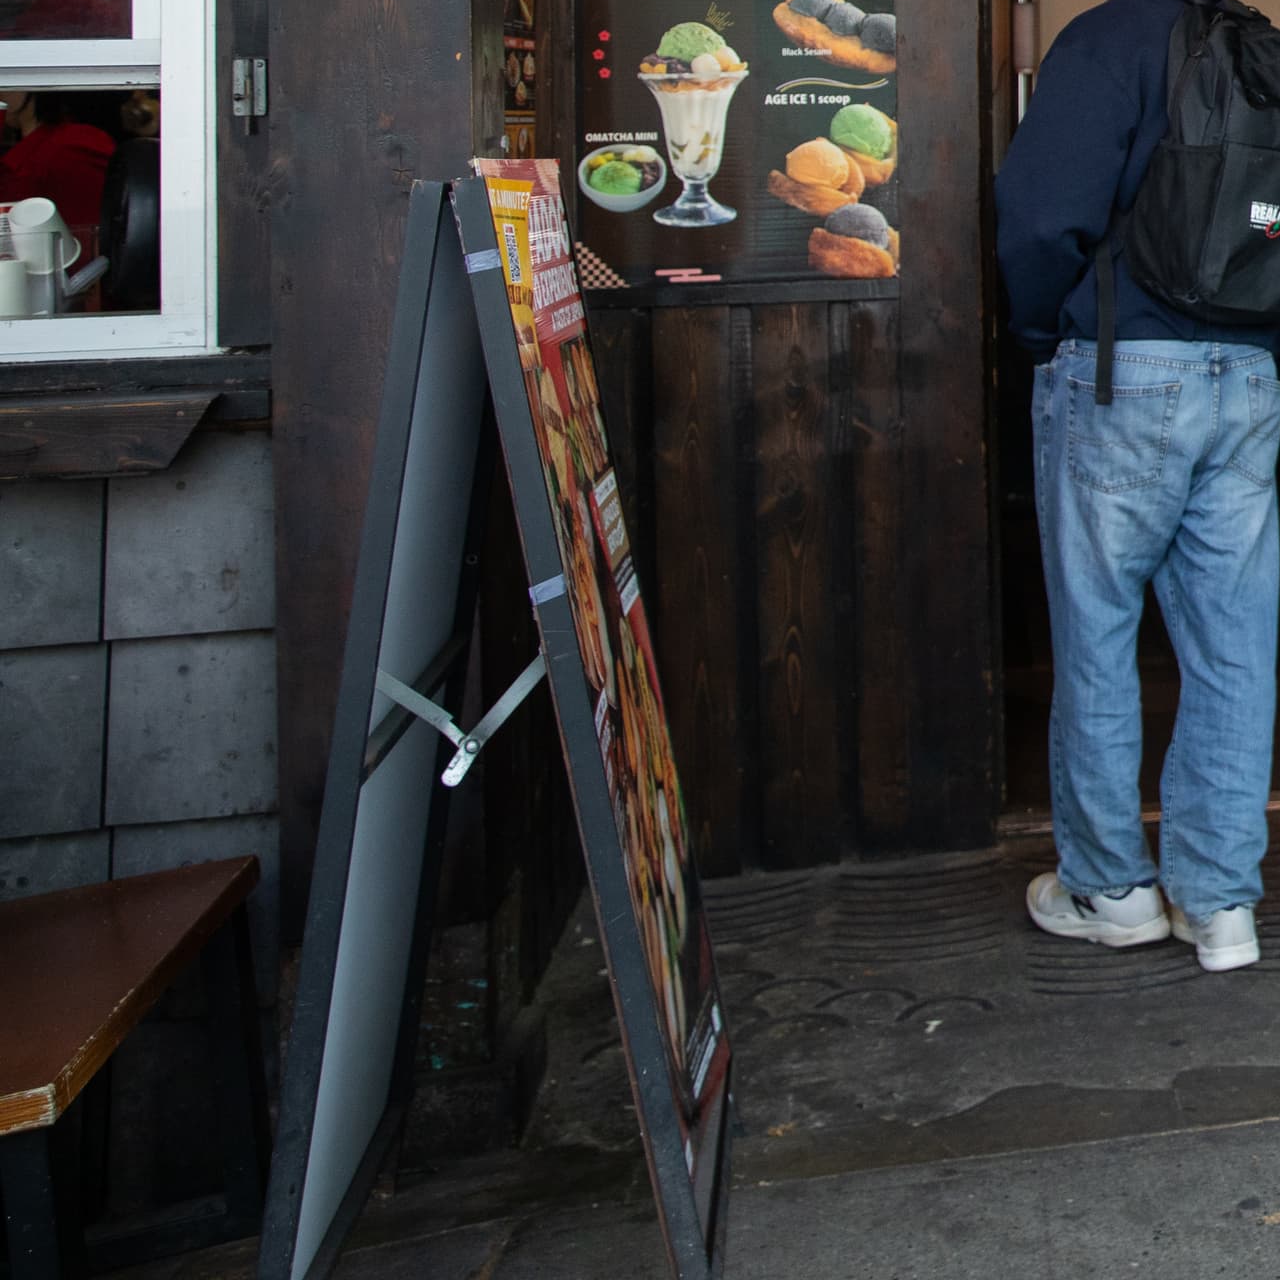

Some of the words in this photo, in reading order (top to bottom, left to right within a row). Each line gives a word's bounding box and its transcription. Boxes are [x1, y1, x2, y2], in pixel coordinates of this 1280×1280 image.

[781, 47, 802, 56] Black
[764, 94, 788, 105] AGE
[789, 94, 807, 104] ICE
[809, 94, 815, 104] 1
[817, 95, 851, 106] scoop
[585, 133, 633, 142] OMATCHA
[635, 132, 658, 142] MINI
